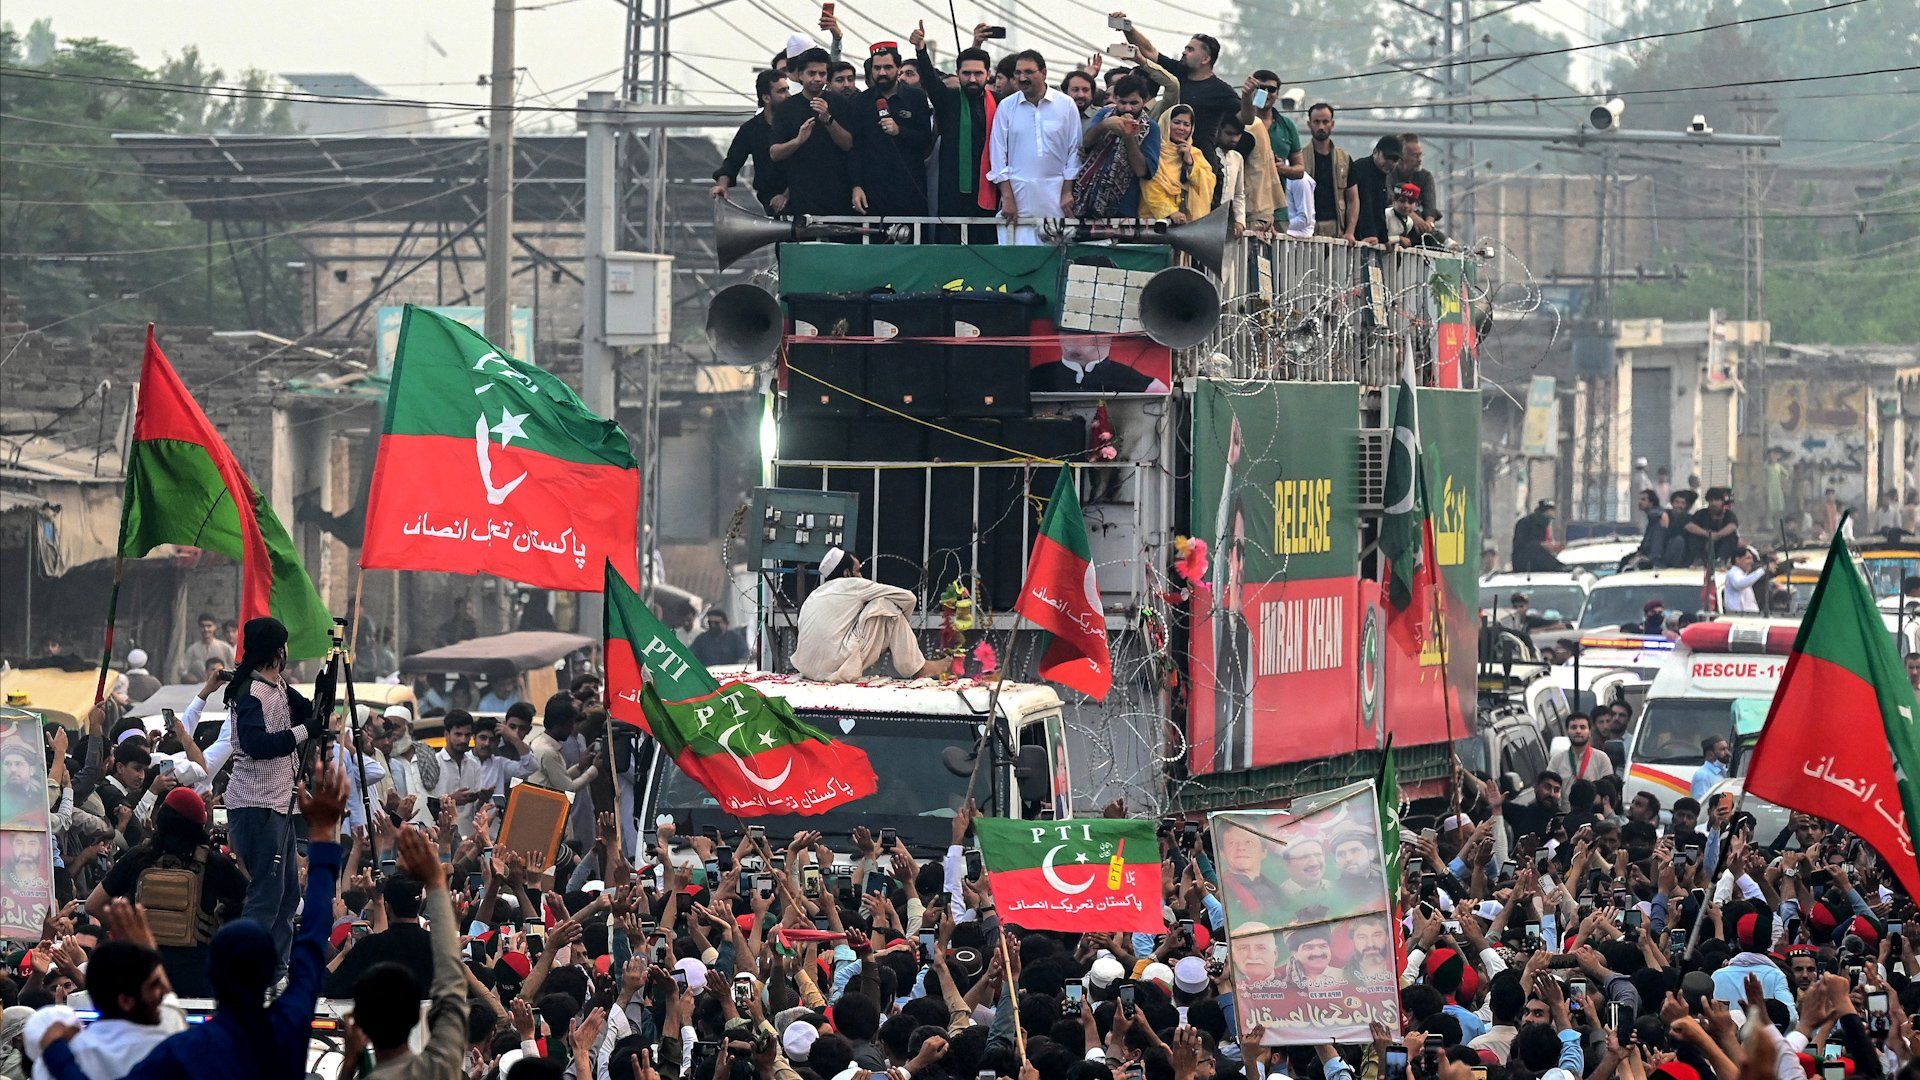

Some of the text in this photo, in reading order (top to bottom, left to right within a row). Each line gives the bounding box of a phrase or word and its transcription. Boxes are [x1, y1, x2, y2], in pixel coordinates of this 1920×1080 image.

[403, 512, 468, 541] انصاف
[1274, 479, 1331, 555] RELEASE
[513, 526, 587, 569] پاکستان
[1032, 586, 1067, 613] انصاف
[1259, 599, 1303, 676] IMRAN
[1306, 596, 1343, 671] KHAN
[641, 635, 691, 683] PTI
[693, 690, 749, 731] PT
[801, 776, 854, 809] پاکستان
[1803, 755, 1877, 803] انصاف
[726, 793, 766, 809] انصاف
[1030, 824, 1093, 844] PTI
[1111, 863, 1121, 882] PTI
[1008, 893, 1143, 914] پاکستان تحریک انصاف
